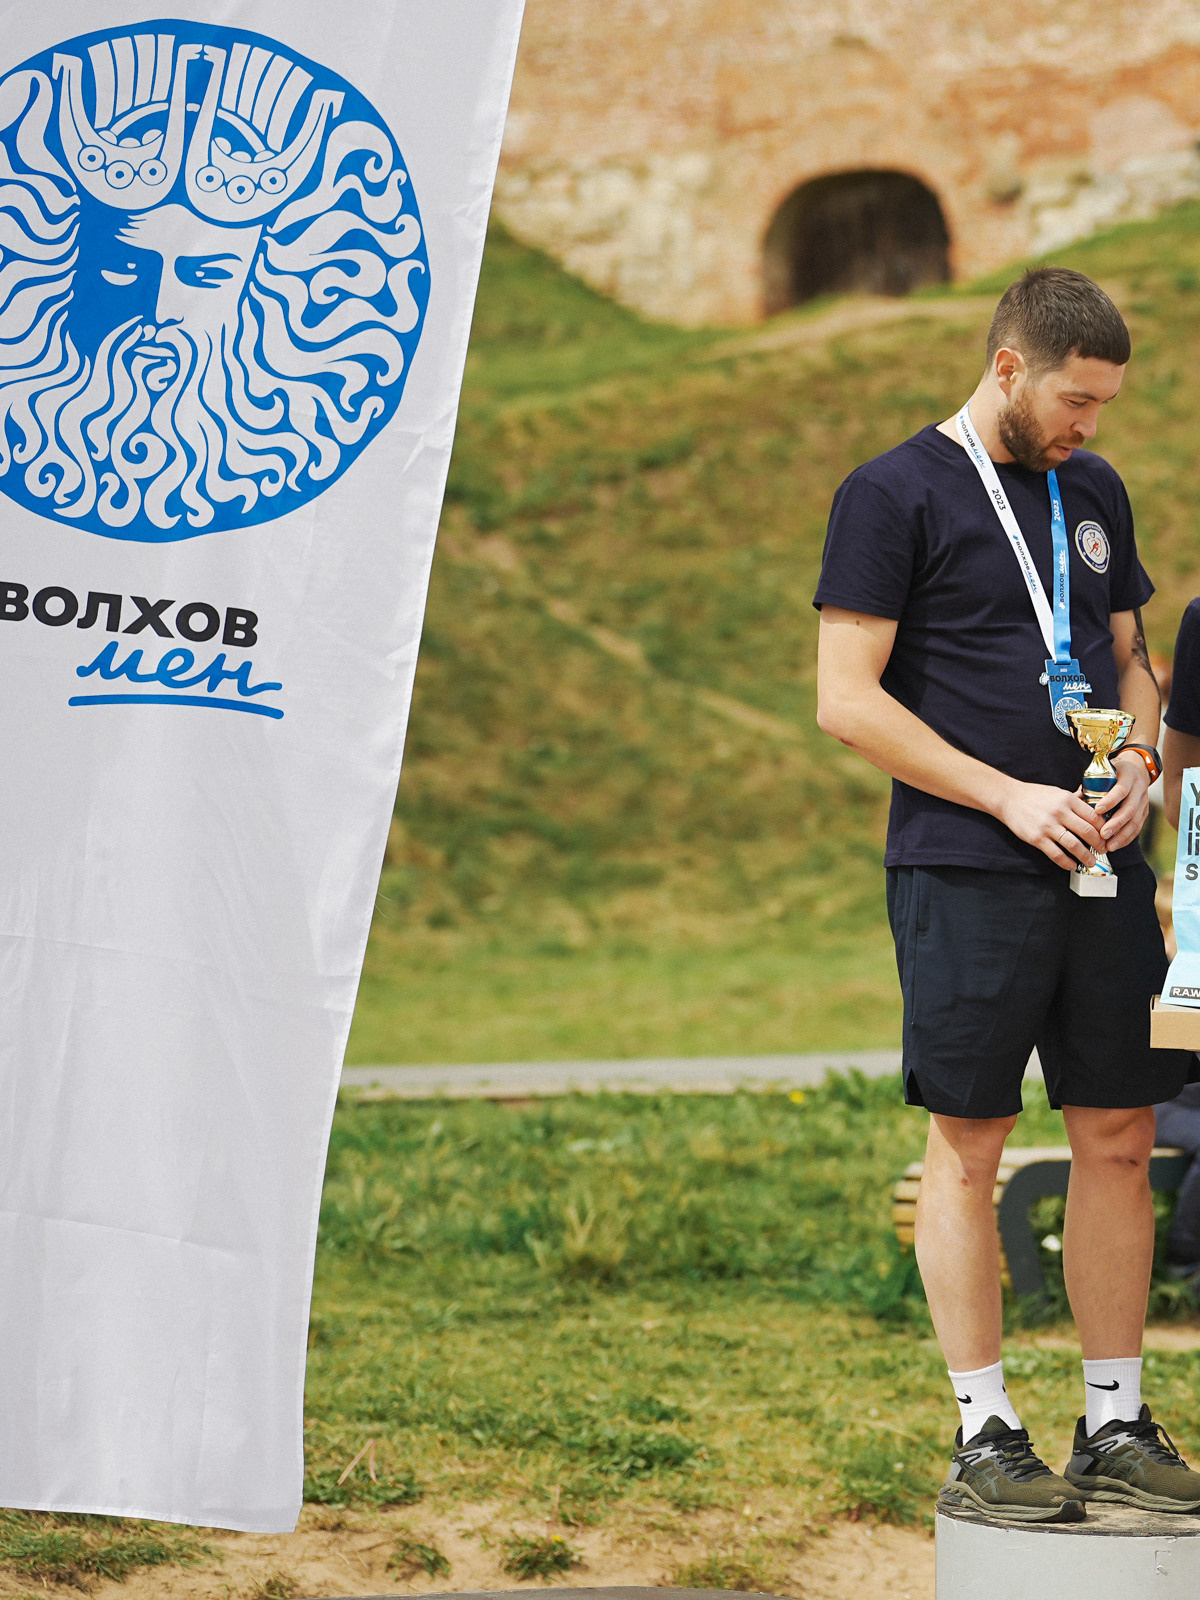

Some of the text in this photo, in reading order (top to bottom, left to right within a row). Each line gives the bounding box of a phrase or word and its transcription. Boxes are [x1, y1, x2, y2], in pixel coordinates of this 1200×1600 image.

[992, 488, 1006, 511] 2023
[1052, 499, 1061, 521] 2023
[0, 581, 260, 648] ВОЛХОВ
[75, 641, 283, 697] мен
